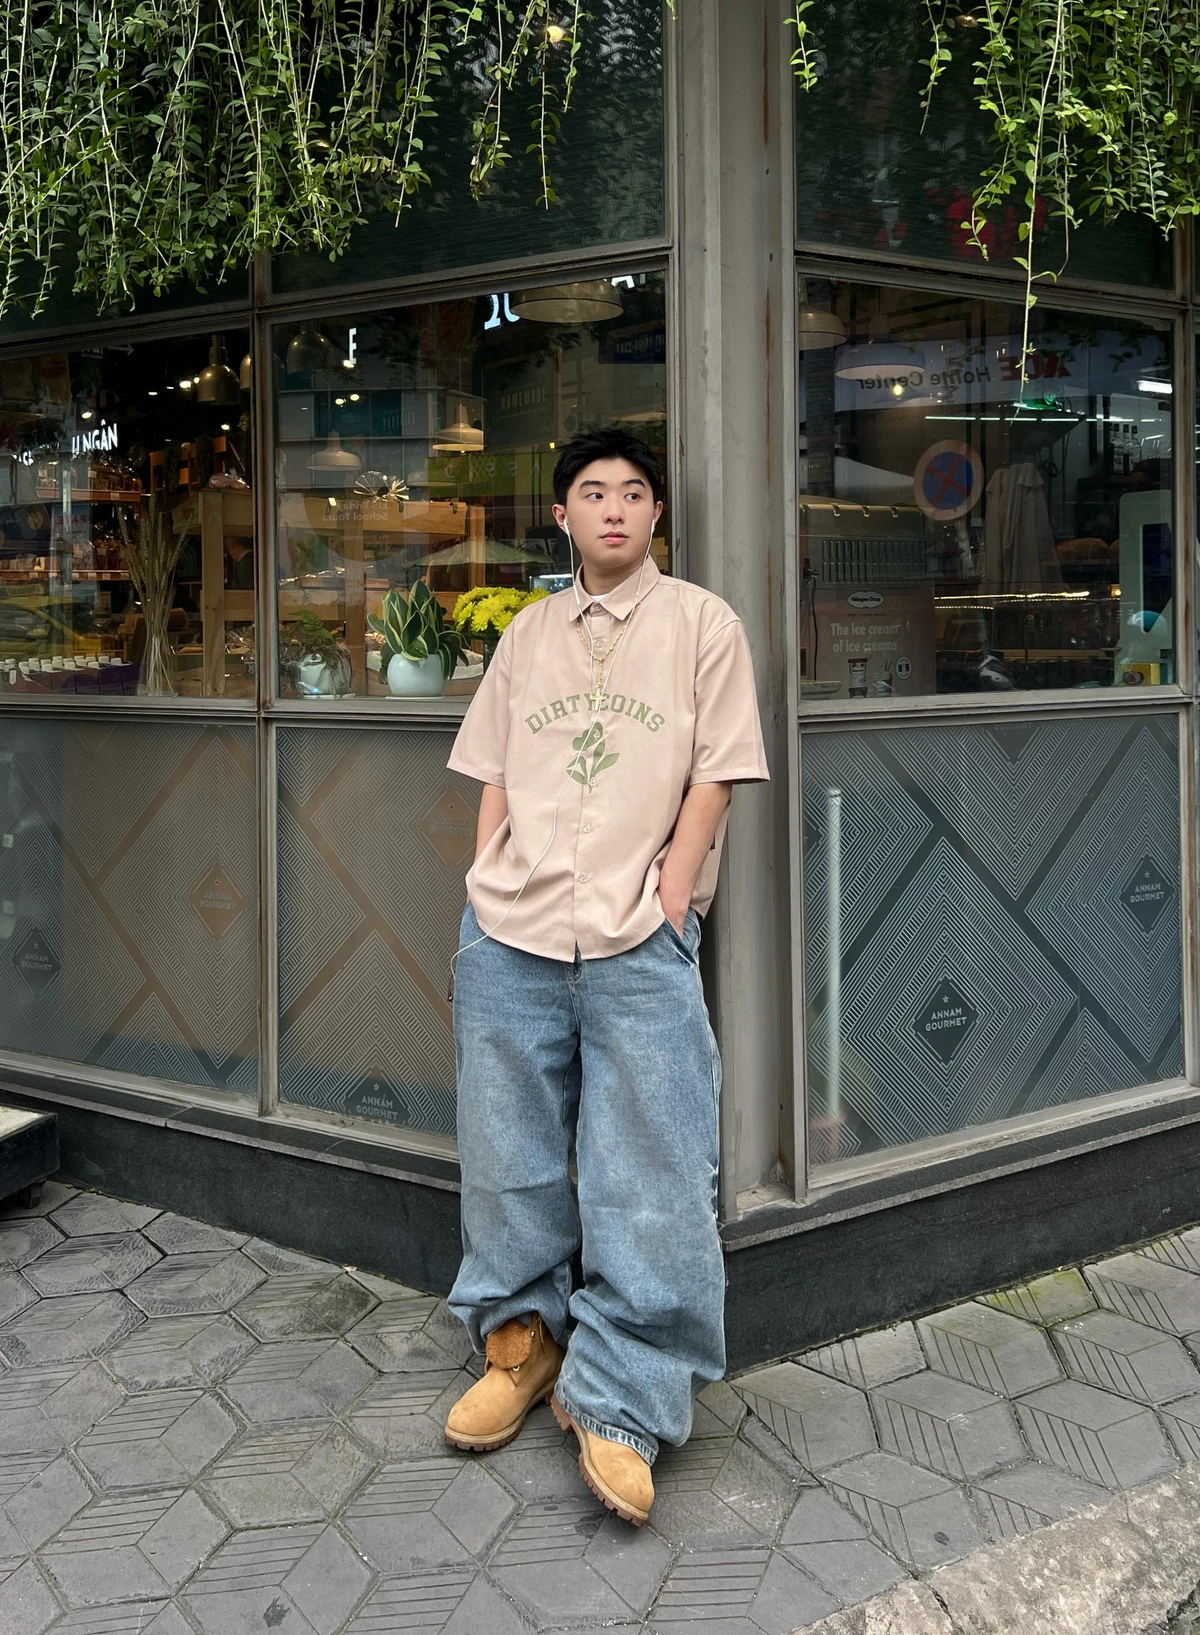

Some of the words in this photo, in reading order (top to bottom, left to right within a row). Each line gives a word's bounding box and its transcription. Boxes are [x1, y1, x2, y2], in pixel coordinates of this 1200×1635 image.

[500, 386, 547, 411] HOMEMADE
[82, 418, 119, 453] NGÂN
[830, 622, 849, 636] The
[851, 622, 866, 636] ice
[868, 624, 900, 636] cream
[832, 639, 845, 653] of
[846, 639, 860, 653] ice
[863, 641, 898, 653] creams
[1134, 882, 1161, 894] ANNAM
[1129, 891, 1165, 903] GOURMET
[25, 952, 49, 963] ANNAM
[20, 960, 53, 972] GOURMET
[930, 1007, 963, 1021] ANNAM
[925, 1016, 967, 1032] GOURMET
[355, 1104, 399, 1121] GOURMET
